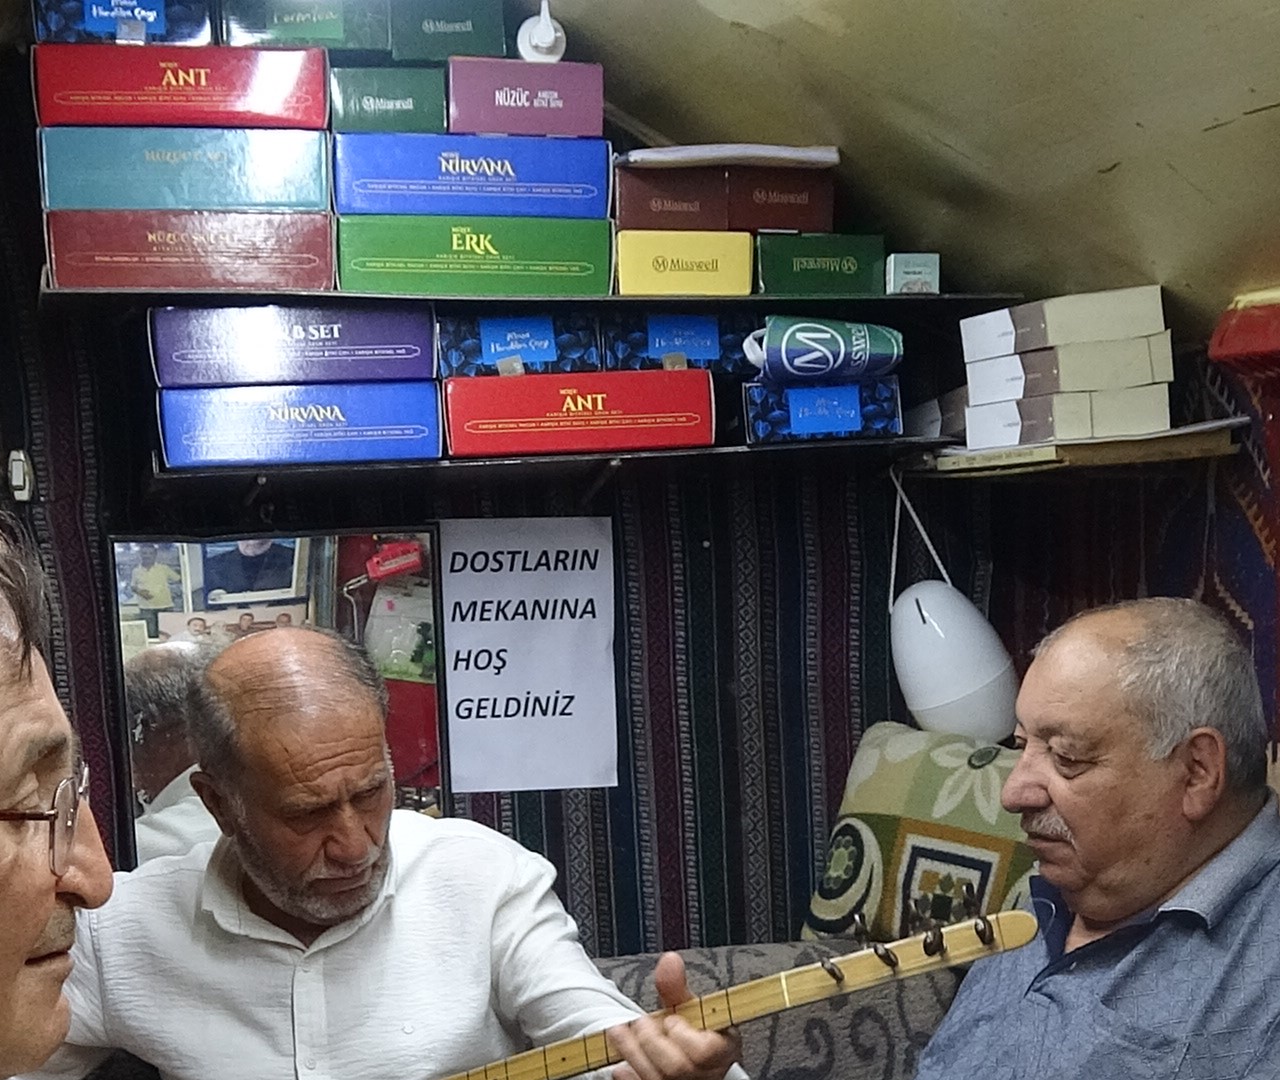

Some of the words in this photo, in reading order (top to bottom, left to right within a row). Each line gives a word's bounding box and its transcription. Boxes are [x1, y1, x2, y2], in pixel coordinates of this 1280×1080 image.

[162, 69, 210, 86] ANT
[451, 233, 499, 255] ERK
[669, 258, 719, 272] Misswell
[308, 324, 342, 340] SET
[562, 394, 607, 411] ANT
[449, 549, 599, 574] DOSTLARIN
[451, 598, 597, 622] MEKANINA
[453, 649, 508, 675] HOŞ
[455, 690, 575, 720] GELDİNİZ
